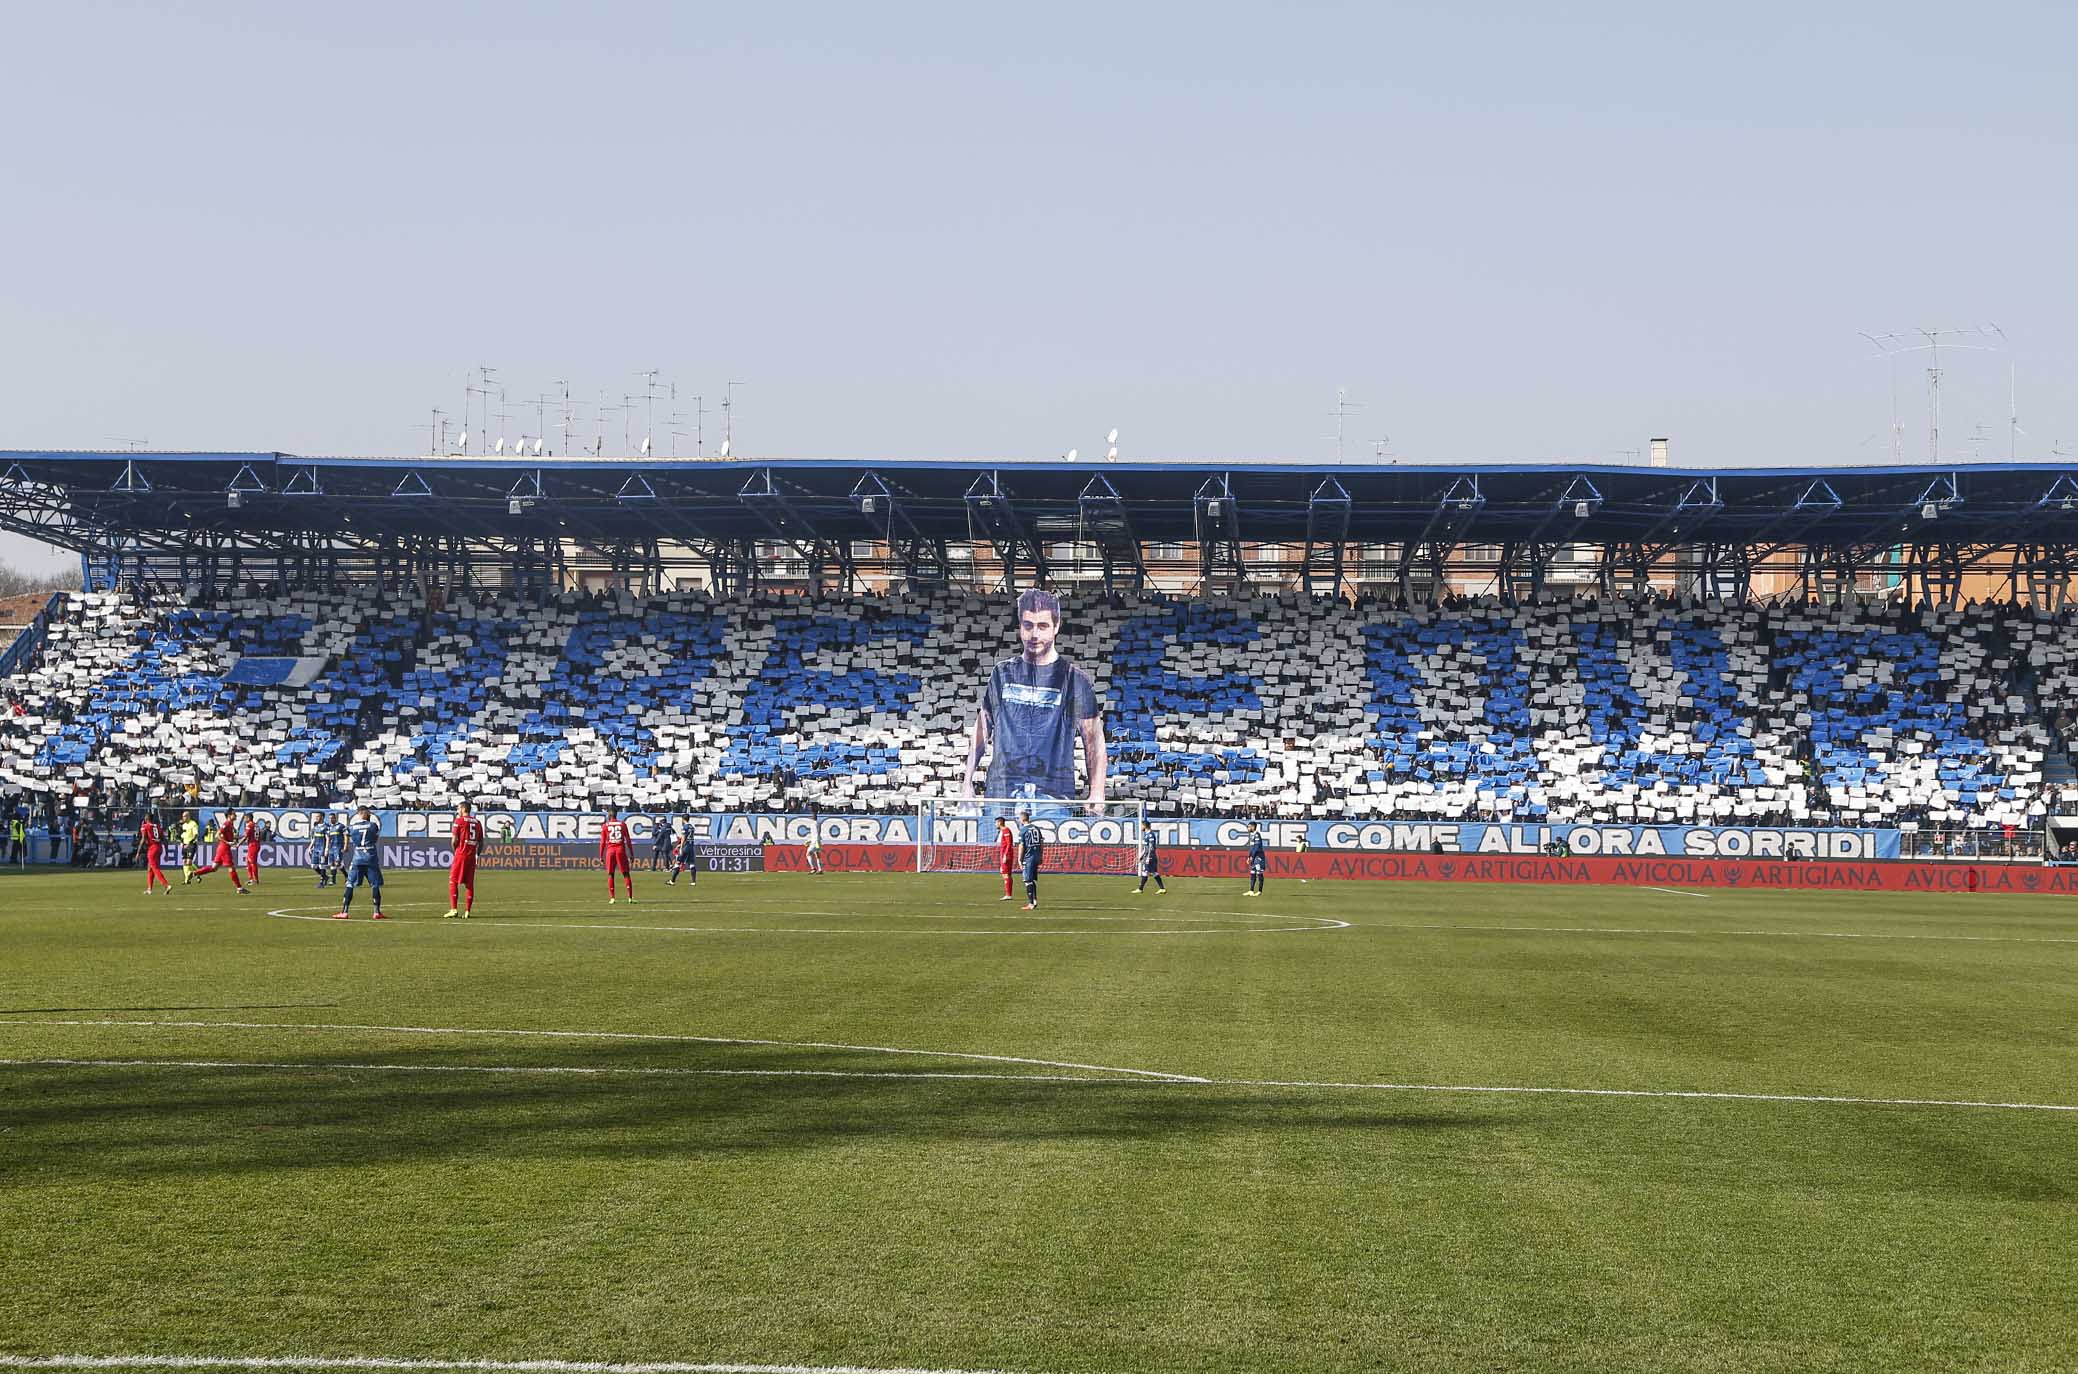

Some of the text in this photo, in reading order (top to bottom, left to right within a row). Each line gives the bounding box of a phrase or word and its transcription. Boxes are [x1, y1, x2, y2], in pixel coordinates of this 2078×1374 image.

[358, 829, 368, 846] 7
[469, 822, 476, 840] 5
[726, 816, 912, 842] ANCORA
[934, 818, 978, 843] MI
[1216, 821, 1309, 847] CHE
[1326, 823, 1461, 852] COME
[1684, 828, 1875, 859] SORRIDI
[480, 845, 526, 856] AVORI
[774, 848, 872, 867] AVOLA
[539, 857, 603, 868] ELETTRIC
[709, 857, 751, 871] 01:31
[1182, 854, 1308, 875] ARTIGNA
[1328, 857, 1592, 881] AVICOLA ARTIGIANA
[1611, 862, 1883, 887] AVICOLA ARTIGIANA
[1904, 867, 2013, 889] AVICOLA
